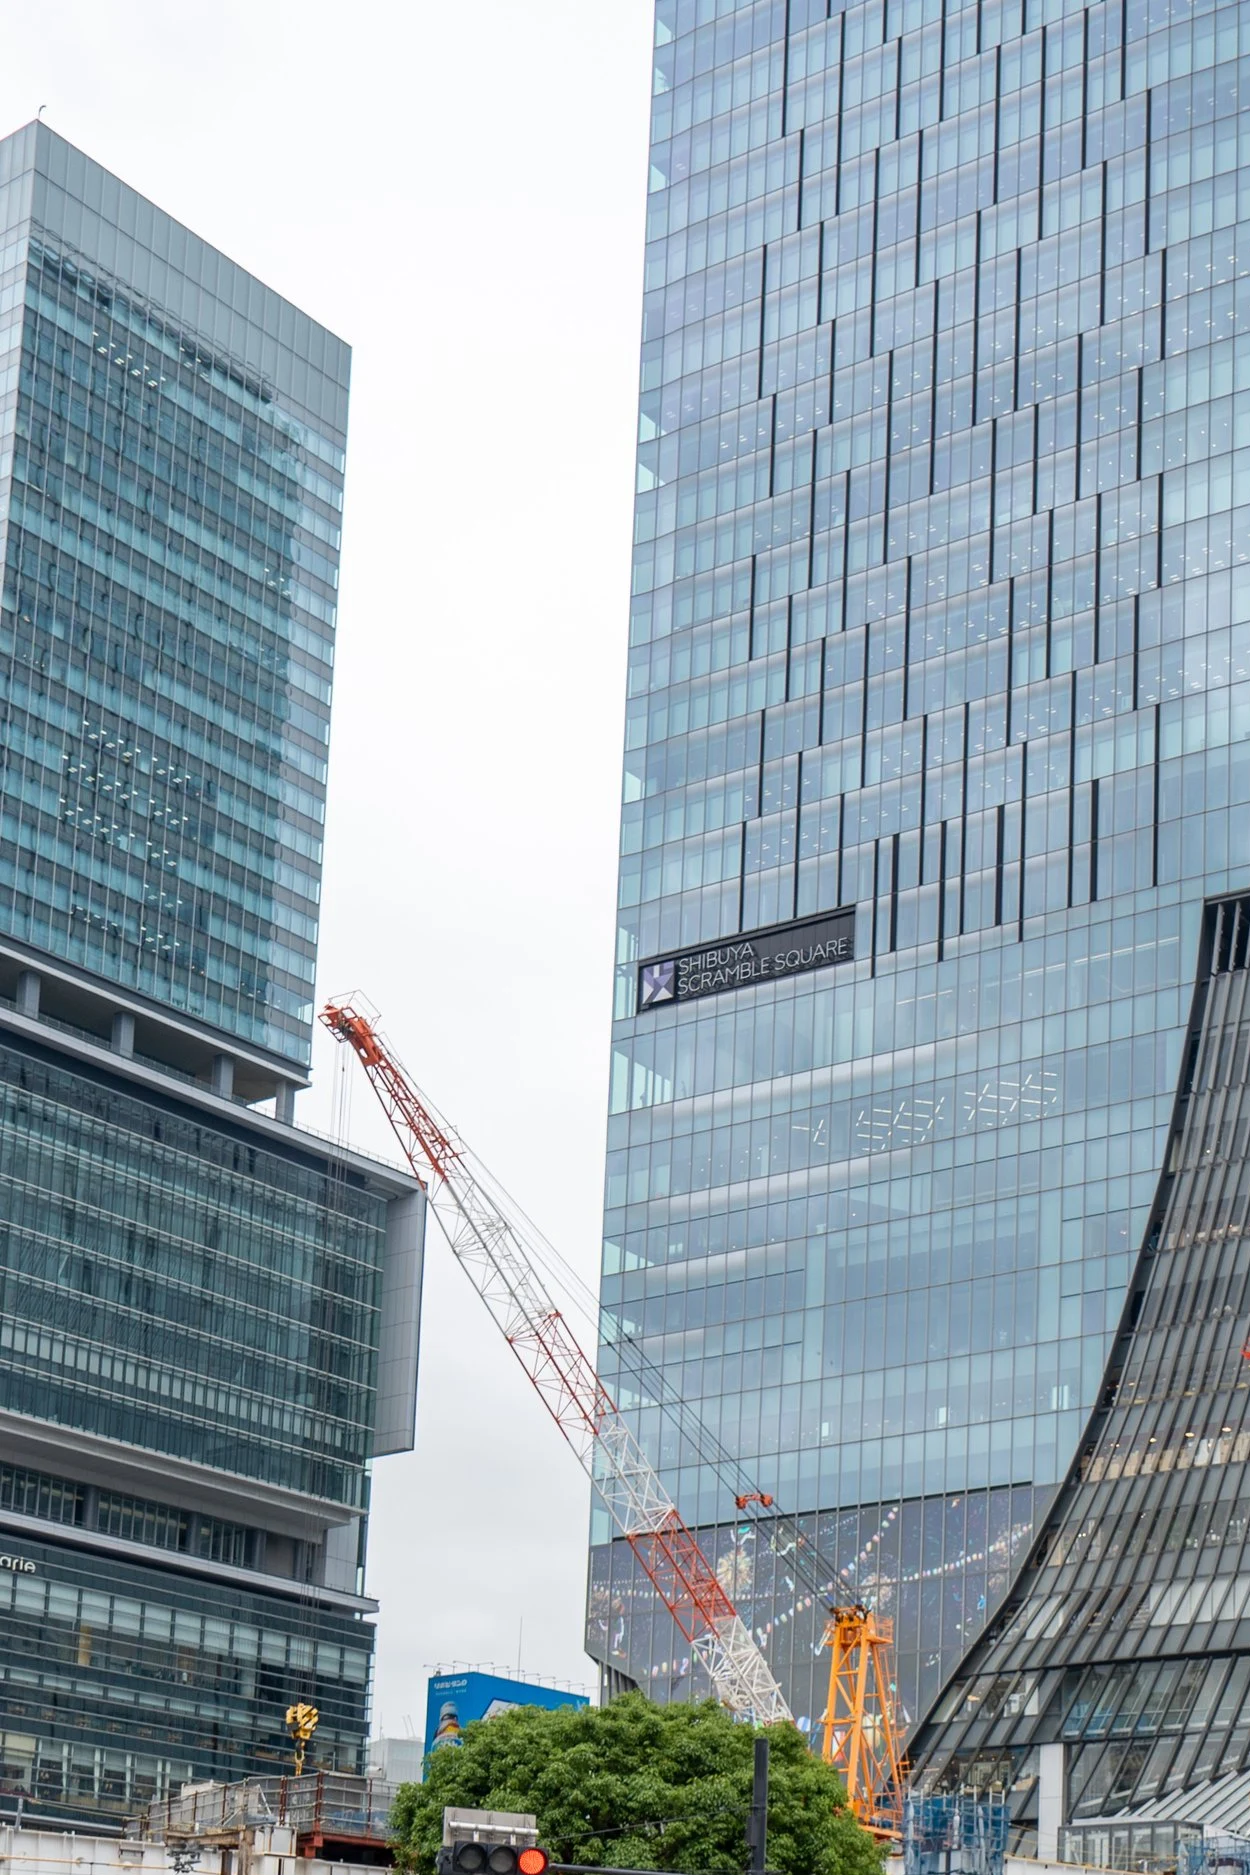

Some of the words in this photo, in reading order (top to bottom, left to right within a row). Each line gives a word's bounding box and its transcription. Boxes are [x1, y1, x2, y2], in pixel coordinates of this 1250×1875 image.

[677, 942, 754, 975] SHIBUYA
[677, 956, 770, 995] SCRAMBLE
[774, 937, 848, 971] SQUARE
